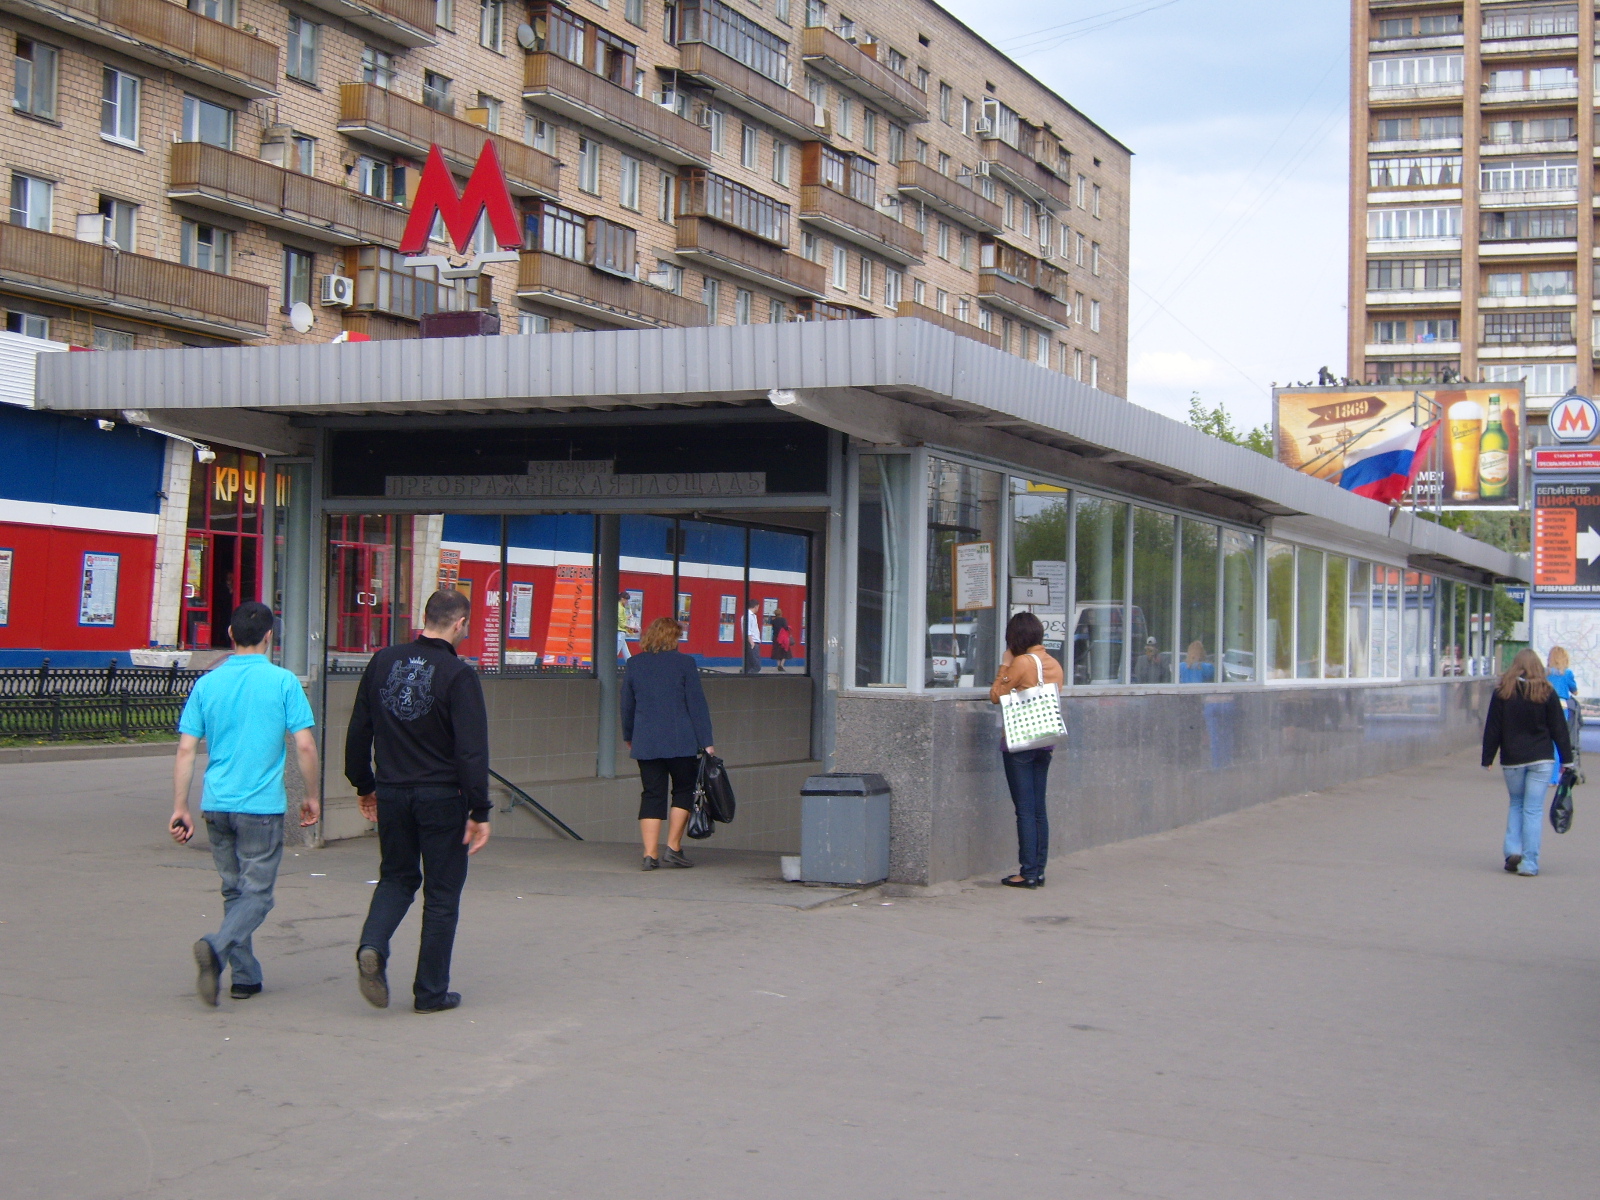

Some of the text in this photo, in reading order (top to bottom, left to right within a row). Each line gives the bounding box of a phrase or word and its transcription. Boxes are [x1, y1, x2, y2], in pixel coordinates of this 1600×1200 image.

[399, 138, 525, 255] М
[1335, 400, 1369, 419] 1869
[1557, 403, 1591, 432] М
[535, 462, 608, 473] СТАНЦИЯ
[392, 473, 760, 495] ПРЕОБРАЖЕНСКАЯ ПЛОЩАДЬ
[1537, 485, 1591, 495] БЕЛЫЙ ВЕТЕР
[557, 566, 579, 578] ОБМЕН
